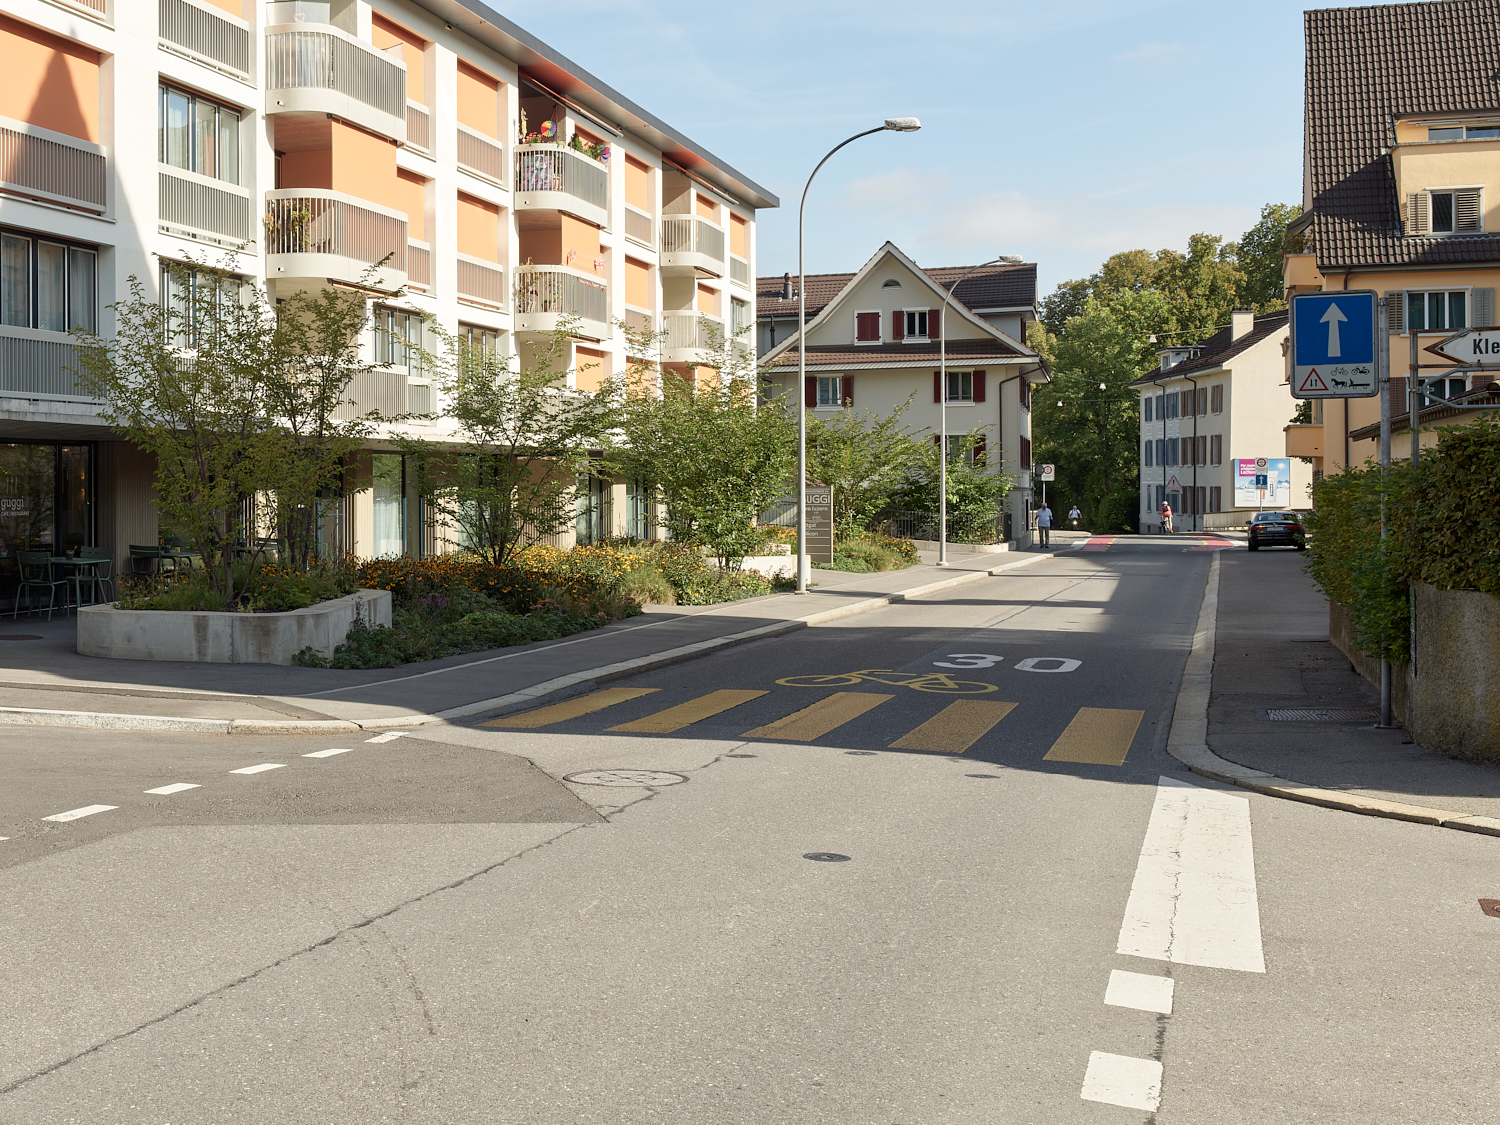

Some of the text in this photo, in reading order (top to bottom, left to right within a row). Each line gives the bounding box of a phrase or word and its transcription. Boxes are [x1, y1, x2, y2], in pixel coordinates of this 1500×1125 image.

[1, 495, 24, 510] guggi
[806, 494, 830, 504] UGGI
[932, 653, 1083, 673] 30
